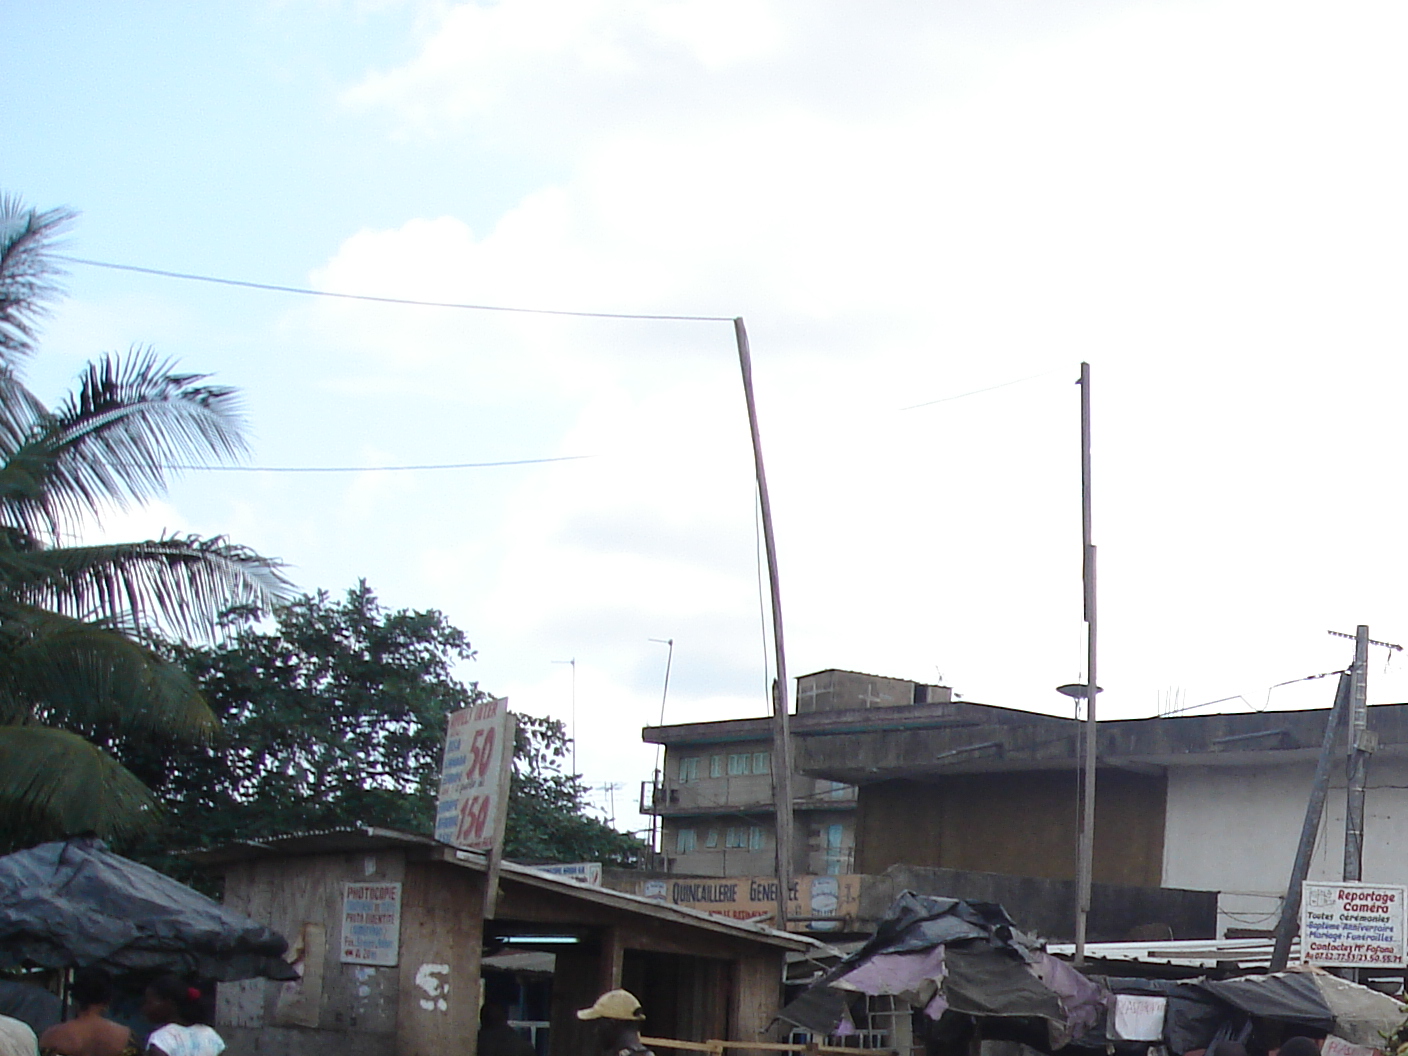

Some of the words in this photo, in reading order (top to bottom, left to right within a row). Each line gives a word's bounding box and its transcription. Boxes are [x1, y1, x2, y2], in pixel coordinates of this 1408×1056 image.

[466, 727, 495, 780] 50
[456, 795, 490, 840] 150
[346, 886, 397, 901] PHOTOCOPIE
[672, 881, 738, 905] QUINCAILLERIE
[750, 879, 799, 902] GENELE
[1338, 889, 1395, 905] Reportage
[1343, 902, 1389, 913] Caméra
[1307, 912, 1333, 920] Toutes
